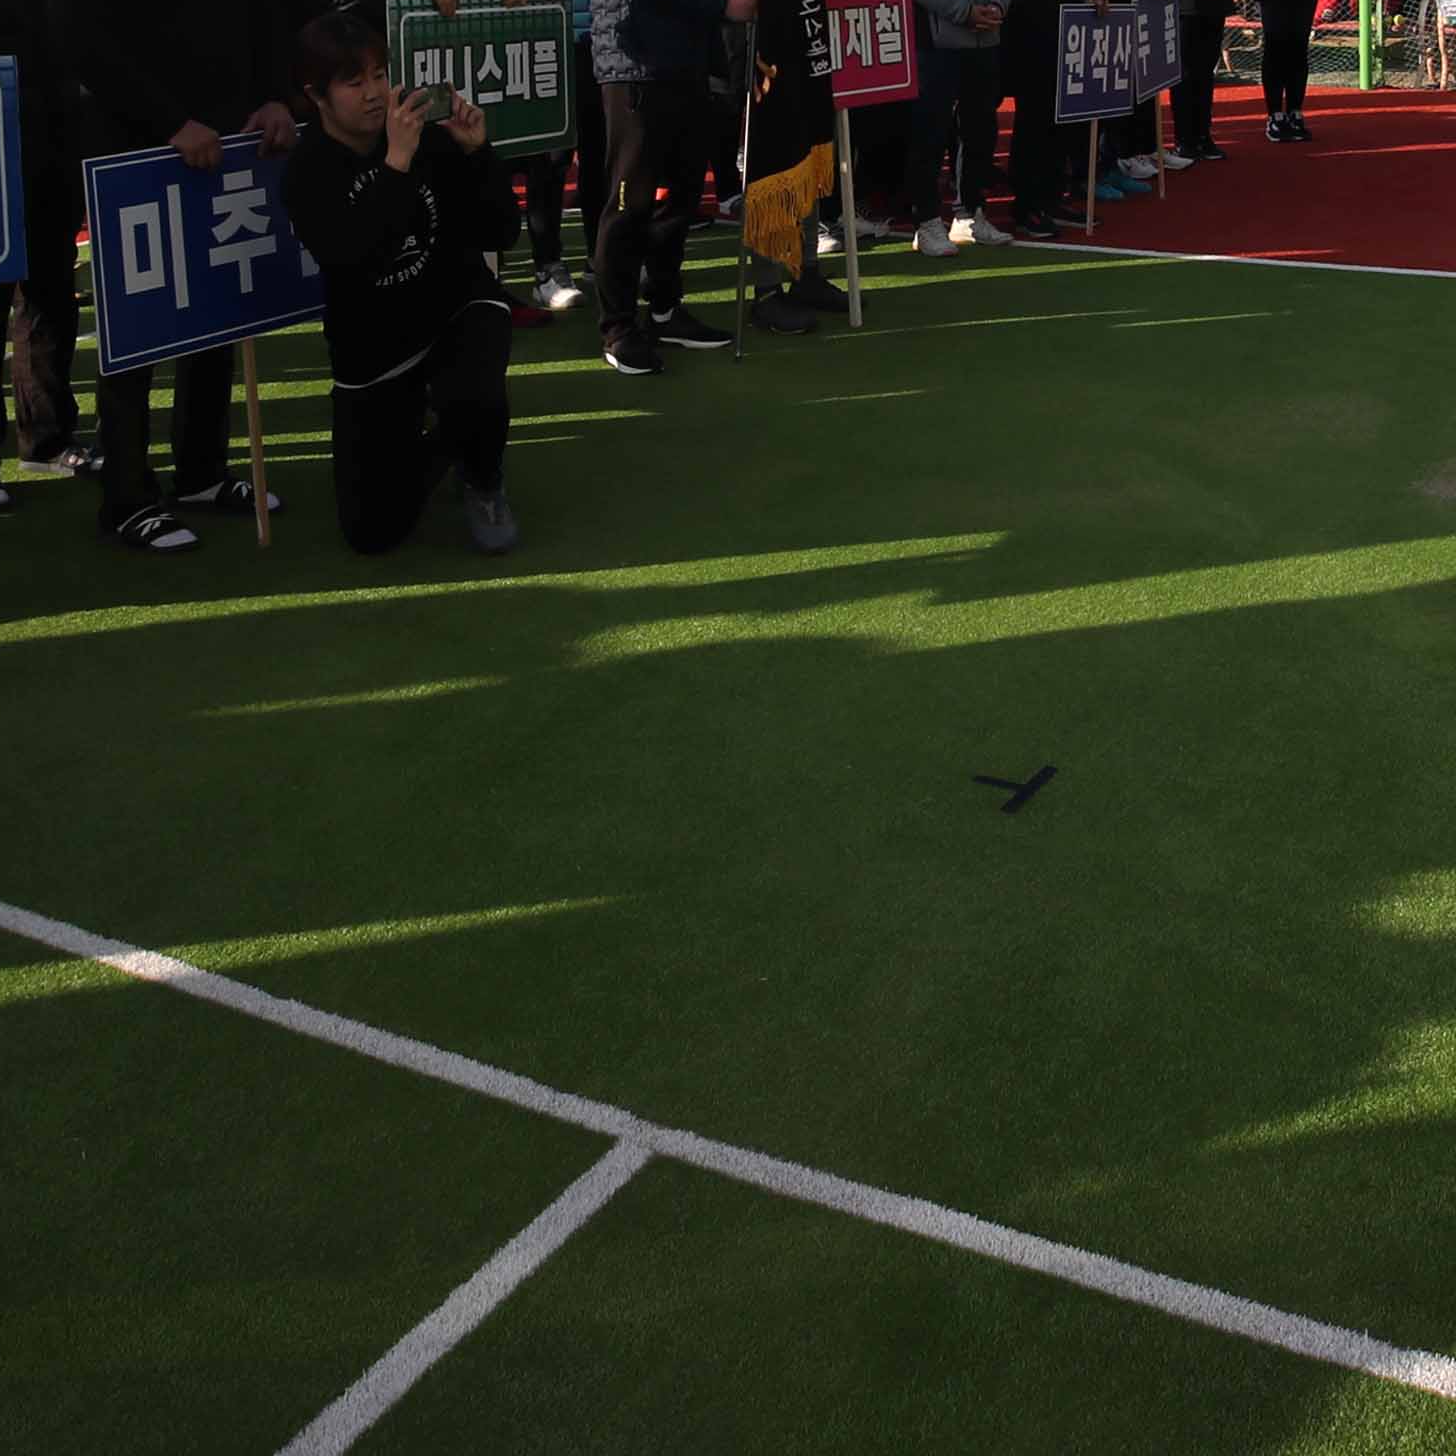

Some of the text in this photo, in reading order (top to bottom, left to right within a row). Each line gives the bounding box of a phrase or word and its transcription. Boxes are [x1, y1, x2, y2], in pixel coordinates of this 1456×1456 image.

[413, 39, 560, 107] 테니스피플
[1064, 24, 1133, 95] 원적산
[118, 168, 321, 310] 미추
